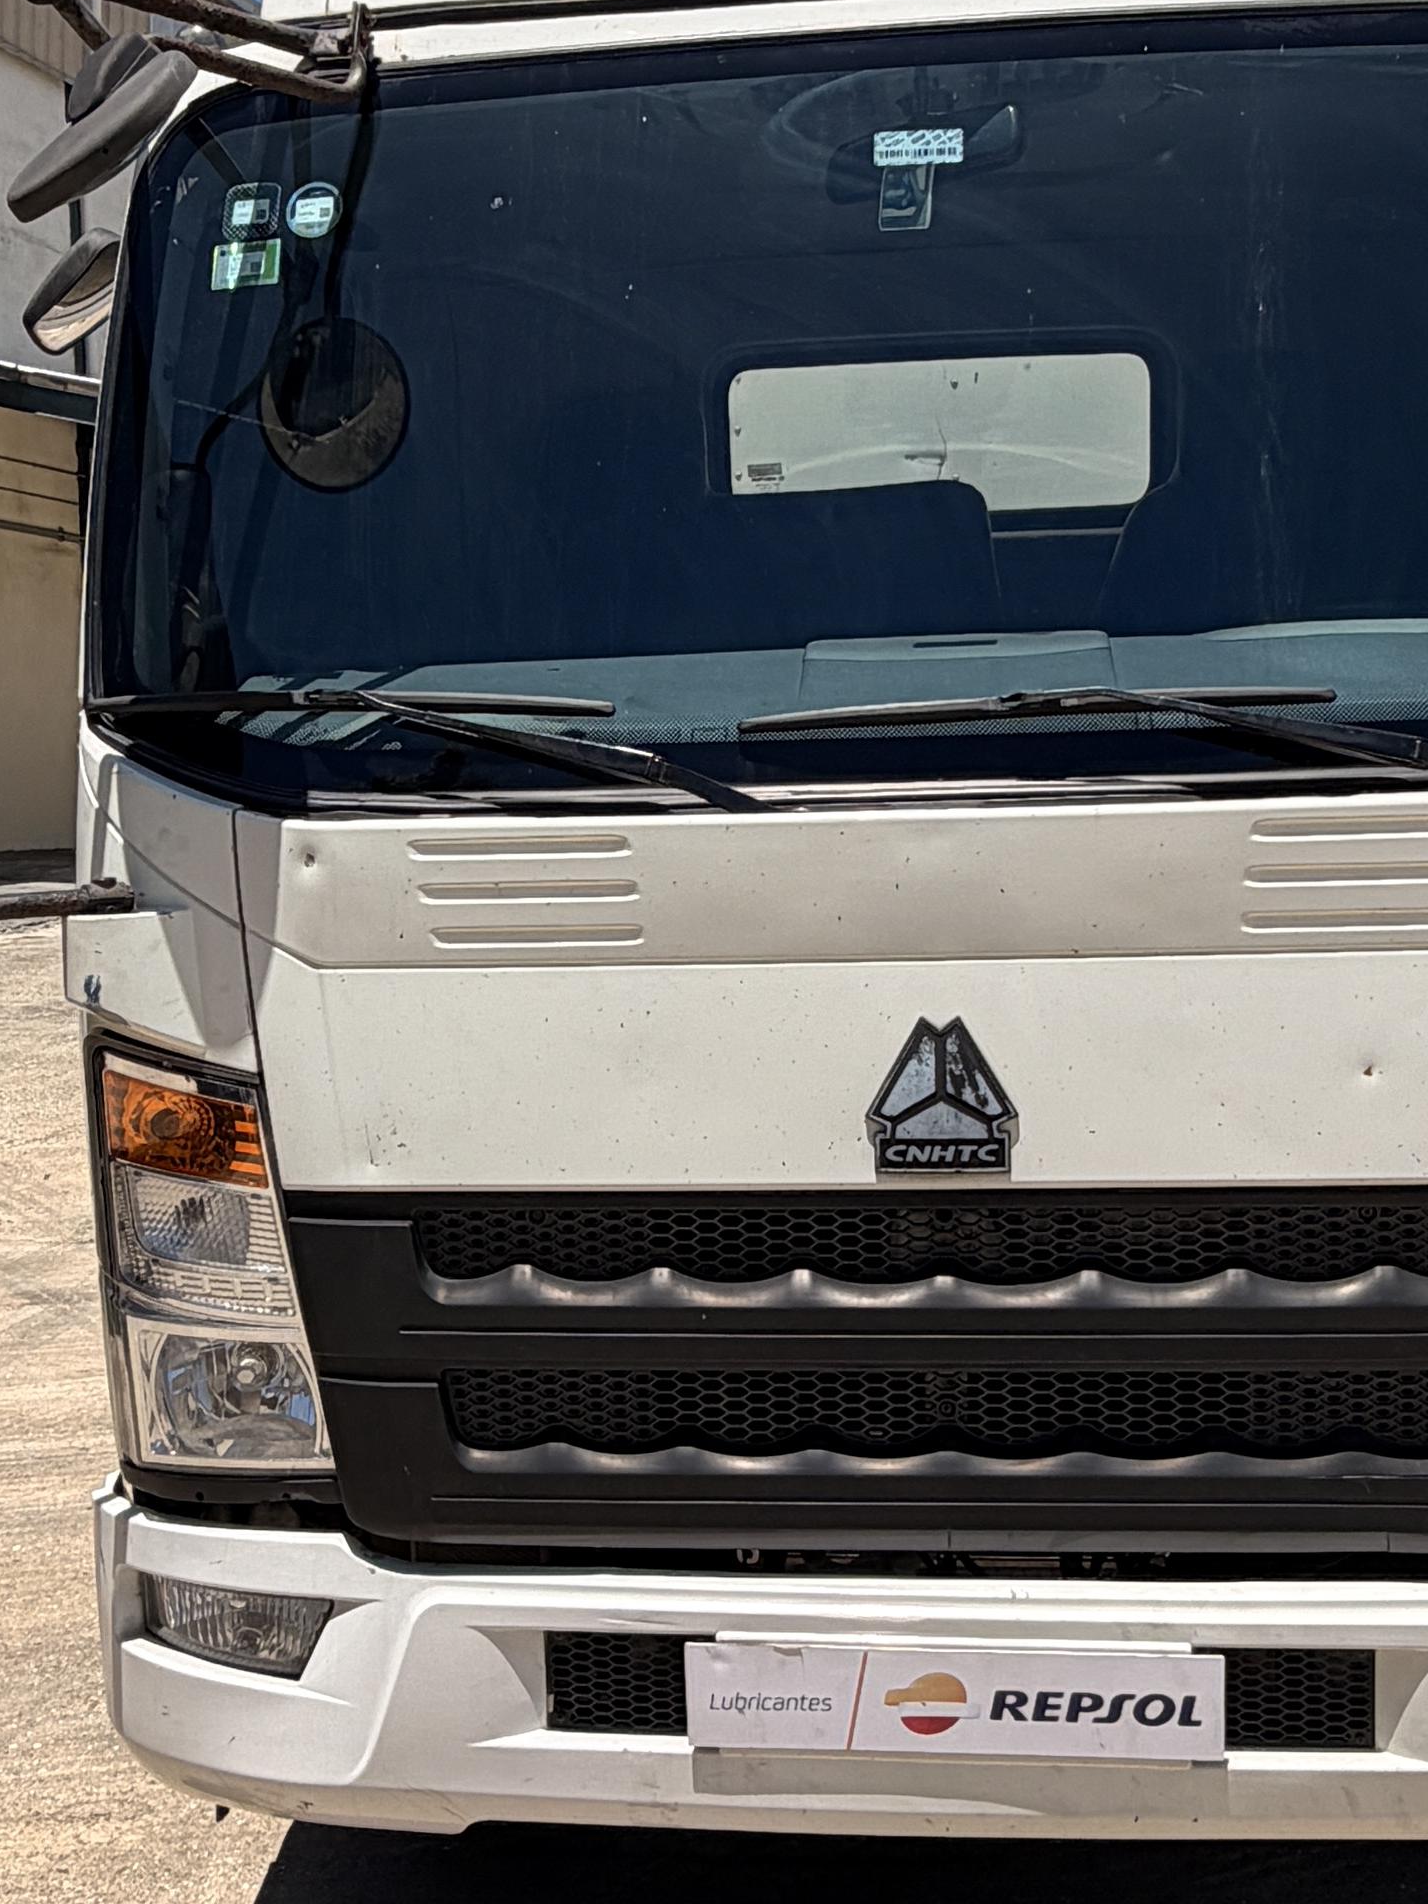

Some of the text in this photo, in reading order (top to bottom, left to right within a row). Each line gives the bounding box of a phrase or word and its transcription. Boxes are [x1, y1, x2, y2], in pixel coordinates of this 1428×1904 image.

[884, 1143, 1000, 1164] CNHTC
[708, 1690, 833, 1717] Lubricantes
[989, 1688, 1204, 1728] REPSOL
